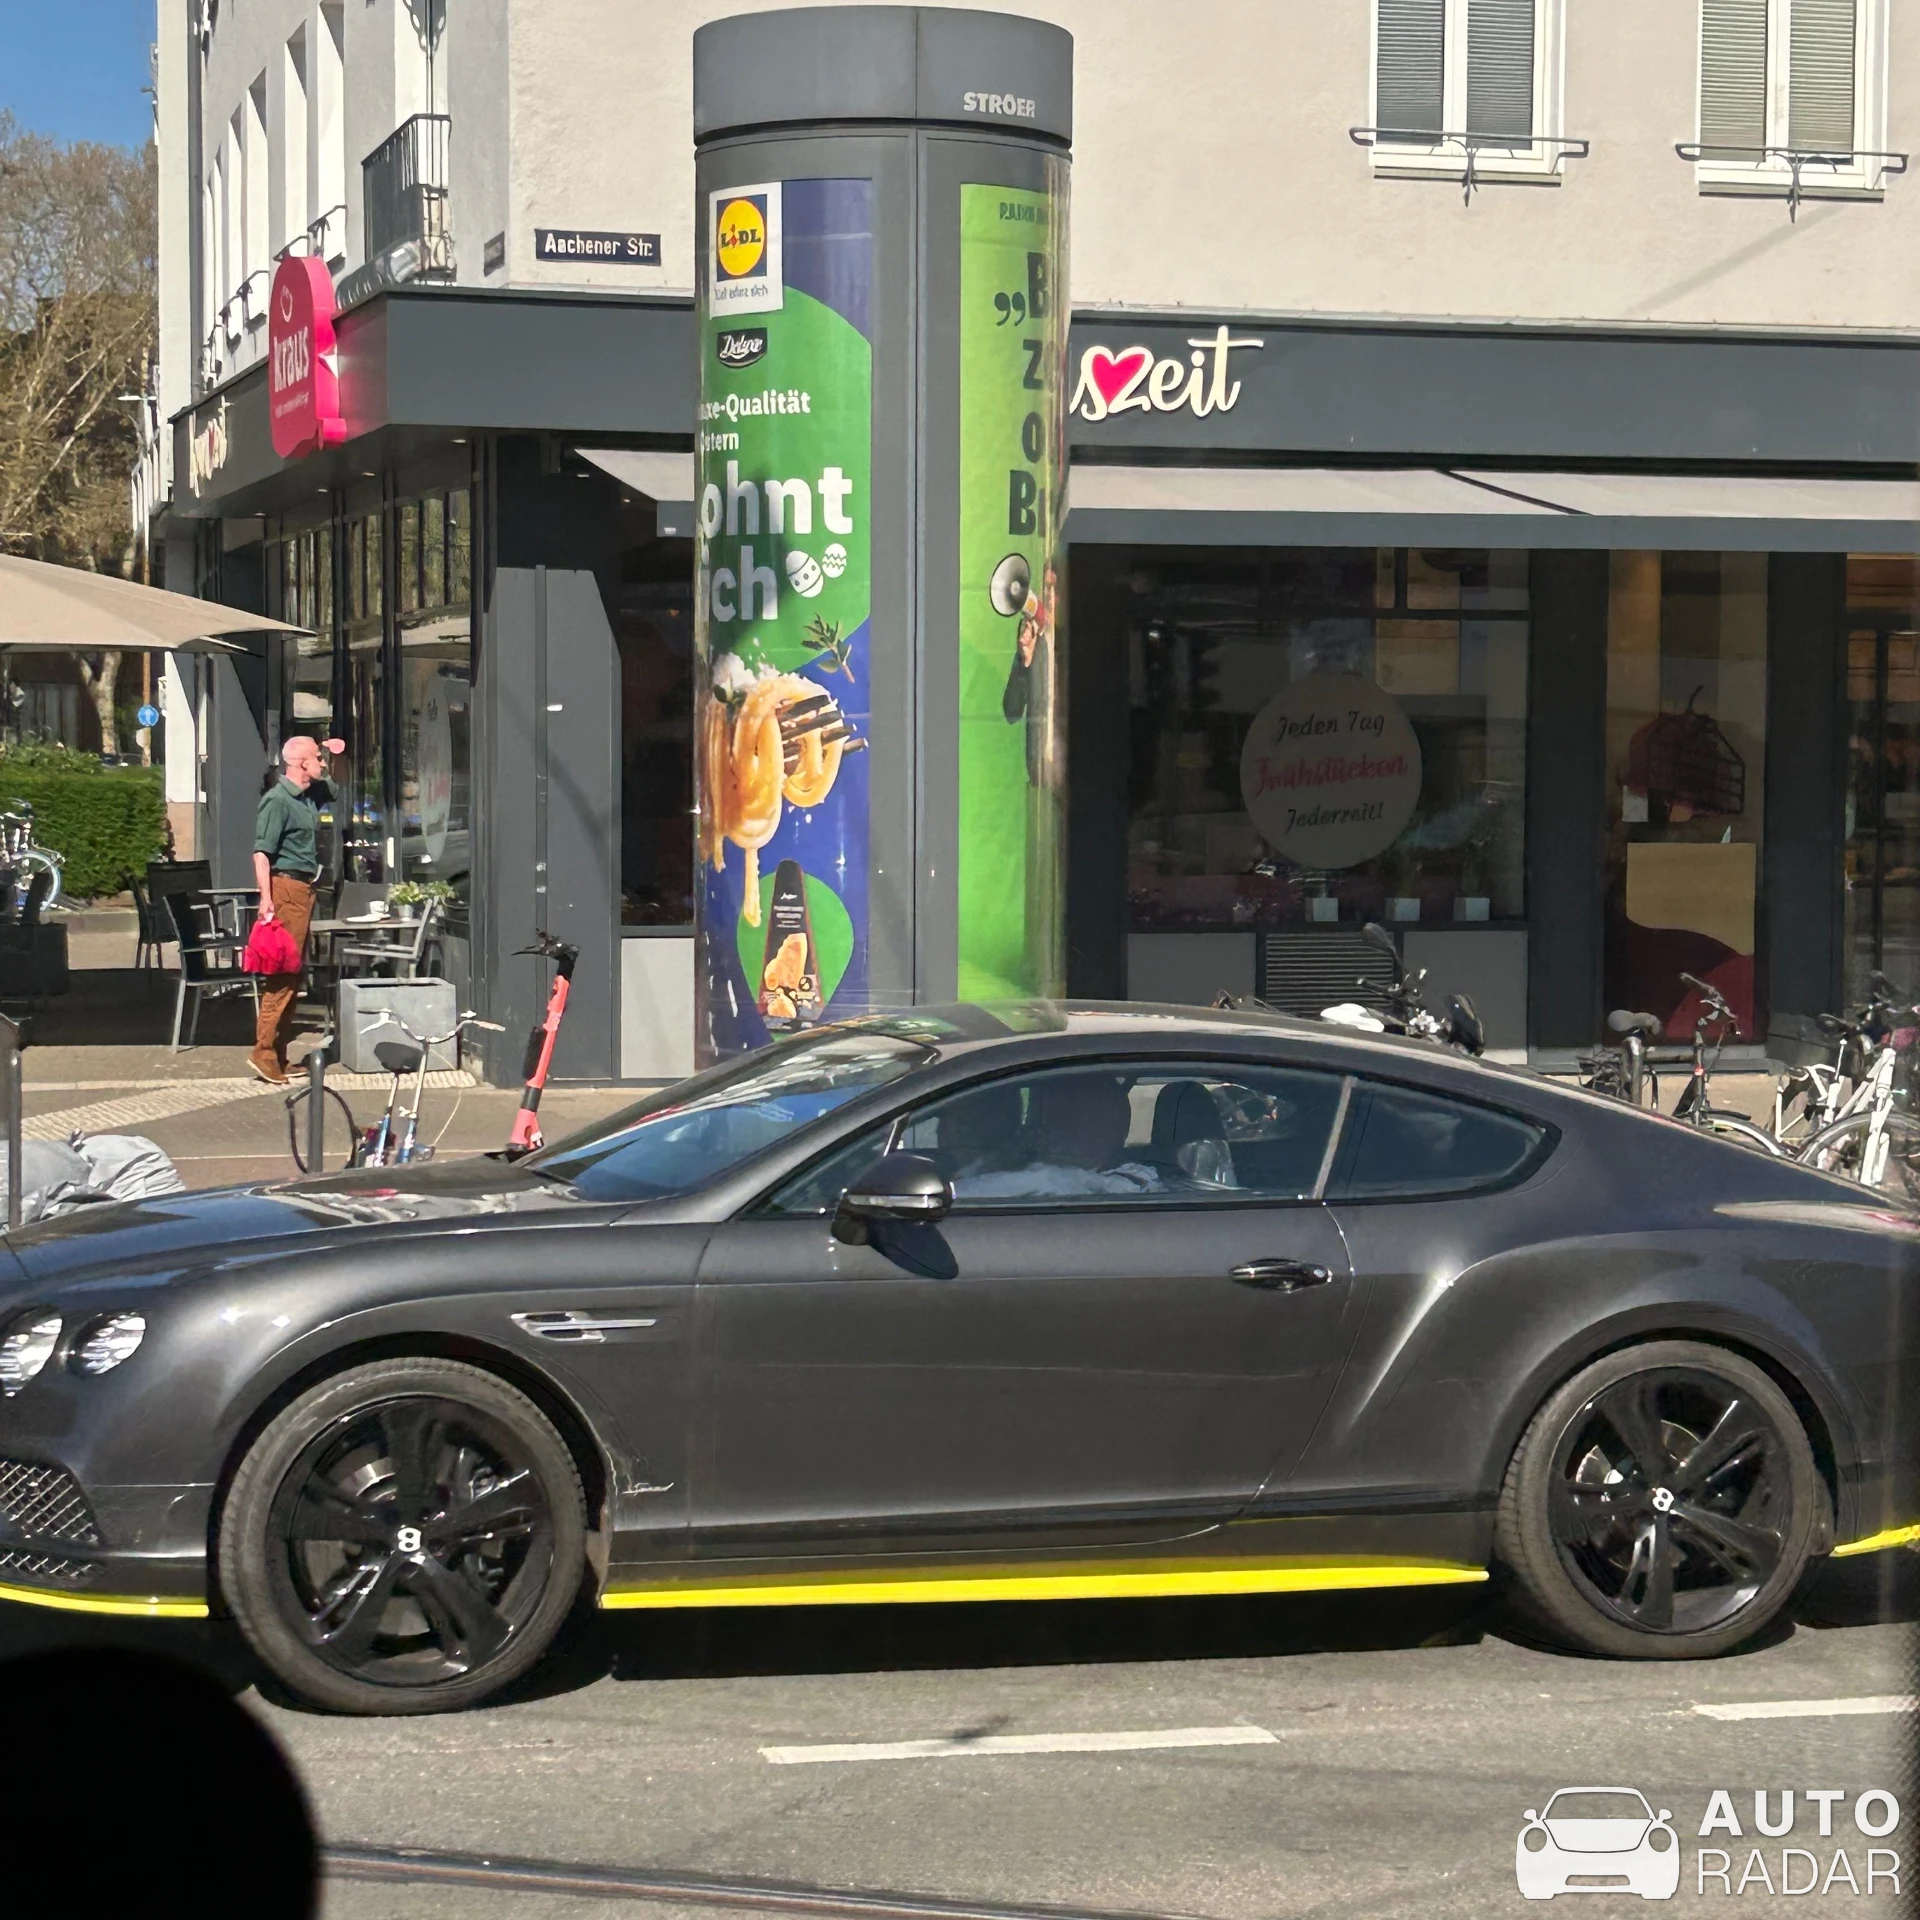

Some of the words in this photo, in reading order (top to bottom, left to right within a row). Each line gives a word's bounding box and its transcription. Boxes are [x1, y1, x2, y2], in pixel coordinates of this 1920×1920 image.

[544, 232, 621, 255] Aachener
[273, 326, 310, 393] kraus
[1276, 713, 1339, 743] Jeden
[1348, 710, 1385, 737] Tag
